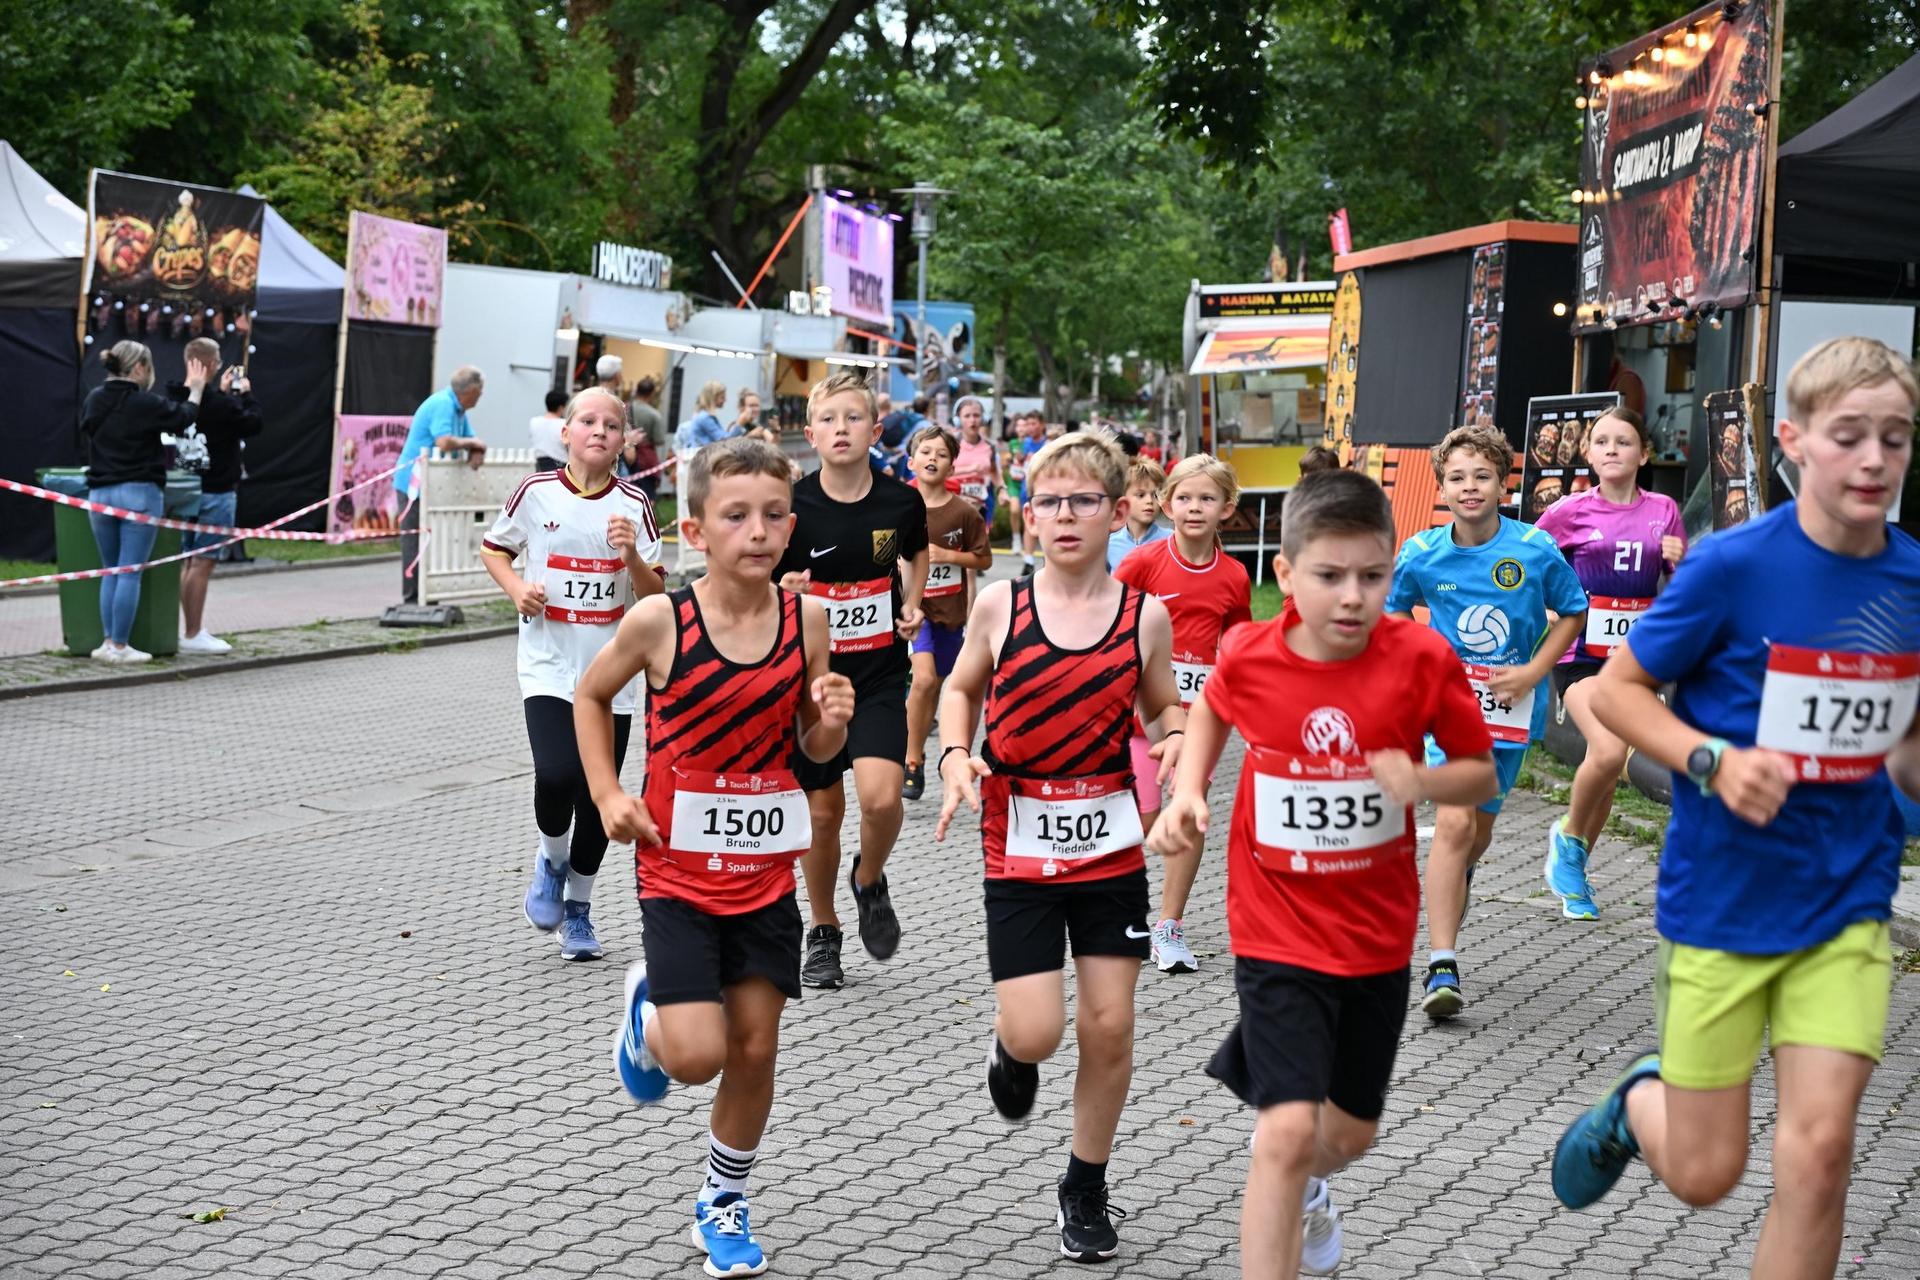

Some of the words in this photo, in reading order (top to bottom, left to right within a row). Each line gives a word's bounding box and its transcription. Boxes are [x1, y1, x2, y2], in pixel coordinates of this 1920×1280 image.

[1613, 140, 1661, 190] SANDWICH
[1660, 135, 1671, 178] &
[598, 240, 664, 290] HANDBROT
[1281, 292, 1336, 304] MATATA
[1614, 541, 1643, 572] 21
[928, 565, 951, 580] 42
[564, 580, 616, 600] 1714
[1437, 583, 1457, 592] JAKO
[582, 600, 597, 608] Lina
[579, 615, 612, 624] Sparkasse
[825, 604, 878, 629] 1282
[841, 629, 859, 637] Finn
[1604, 617, 1638, 636] 10
[1473, 690, 1512, 714] 334
[1799, 695, 1893, 734] 1791
[730, 781, 750, 789] Tauch
[1282, 792, 1383, 830] 1335
[703, 807, 784, 837] 1500
[1037, 810, 1110, 843] 1502
[726, 838, 761, 848] Bruno
[1052, 842, 1096, 854] Friedrich
[1314, 835, 1349, 847] Theo
[1312, 857, 1372, 873] Sparkasse
